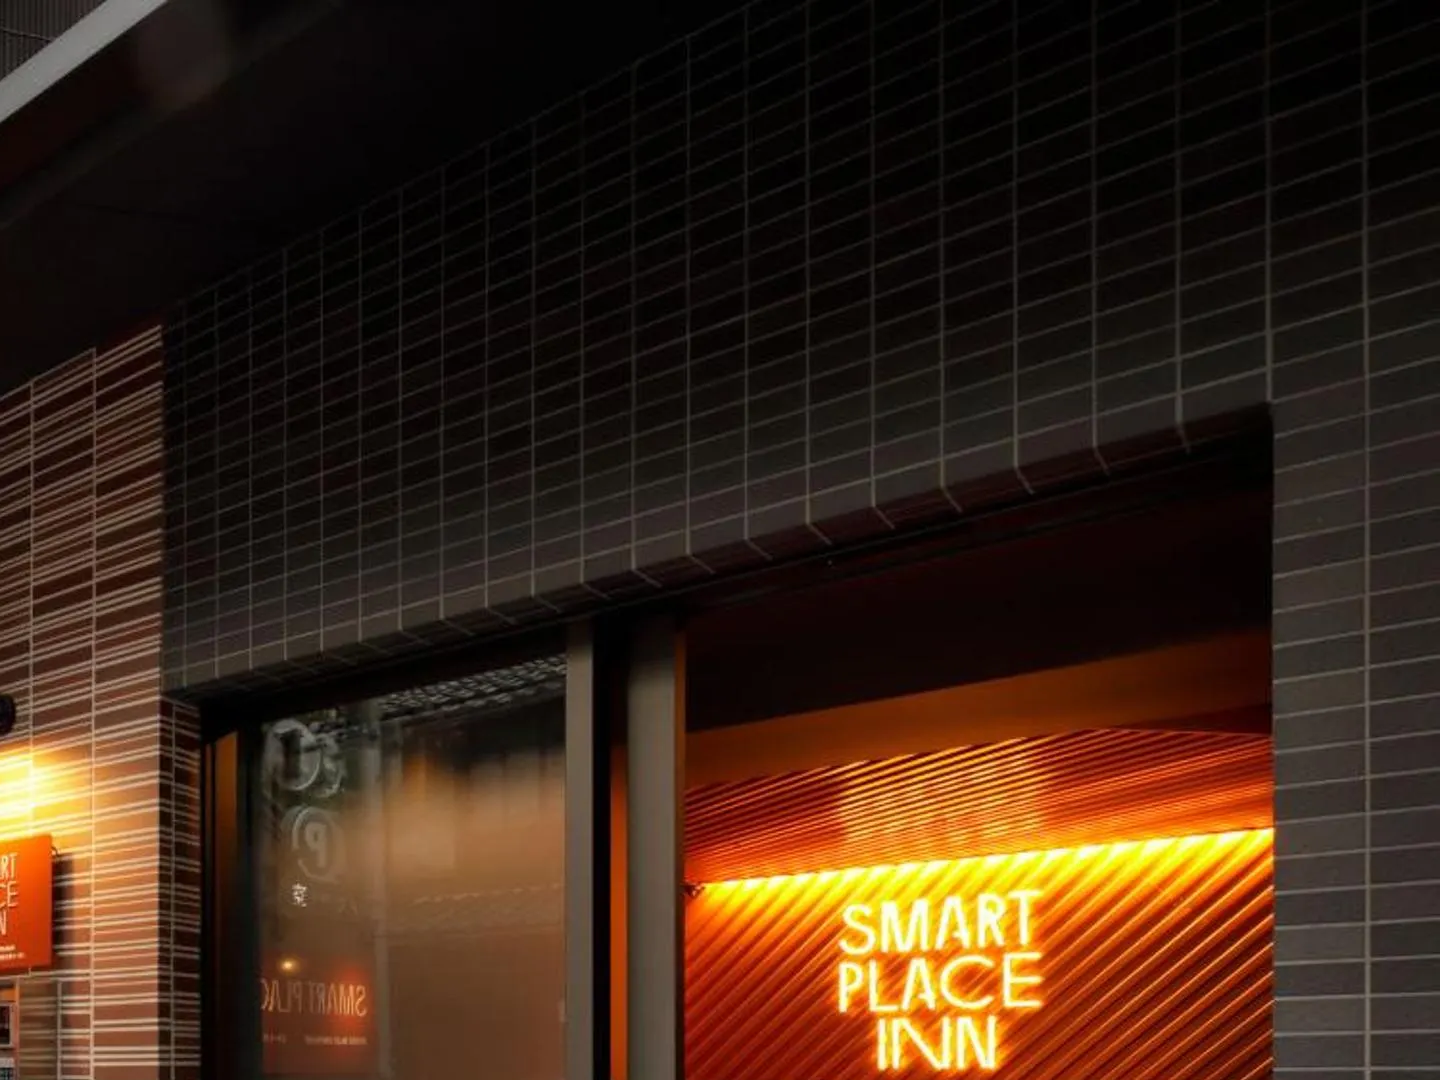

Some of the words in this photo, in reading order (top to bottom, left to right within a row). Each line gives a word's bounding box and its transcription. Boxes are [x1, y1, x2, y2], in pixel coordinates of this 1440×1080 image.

[837, 888, 1044, 956] SMART
[837, 951, 1045, 1013] PLACE
[876, 1014, 997, 1071] INN
